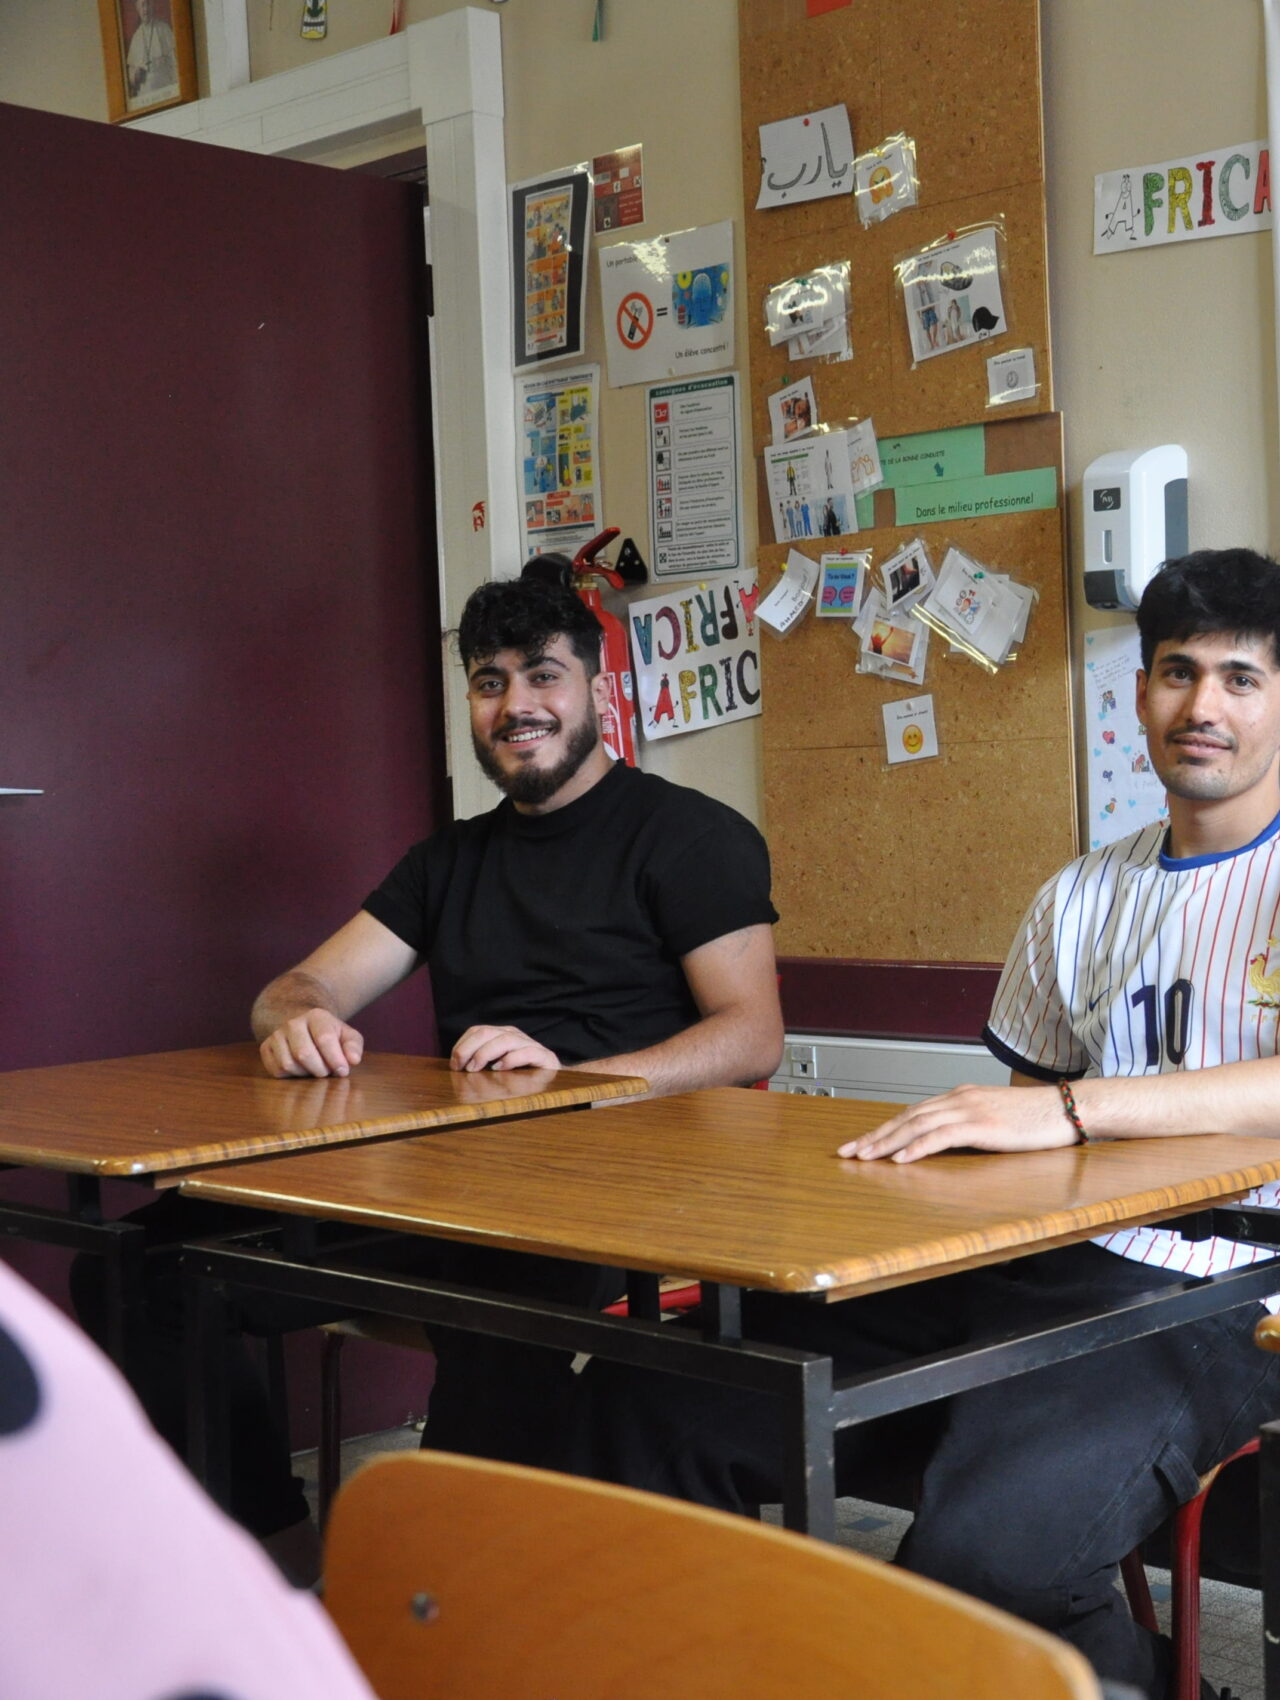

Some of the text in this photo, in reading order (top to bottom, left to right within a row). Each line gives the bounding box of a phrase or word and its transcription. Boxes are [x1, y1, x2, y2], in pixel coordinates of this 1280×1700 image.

[1101, 149, 1272, 241] AFRICA
[915, 493, 1034, 518] Dans le milieu professionnel
[633, 581, 760, 666] AFRICA
[648, 649, 761, 729] AFRIC
[1131, 978, 1194, 1067] 10
